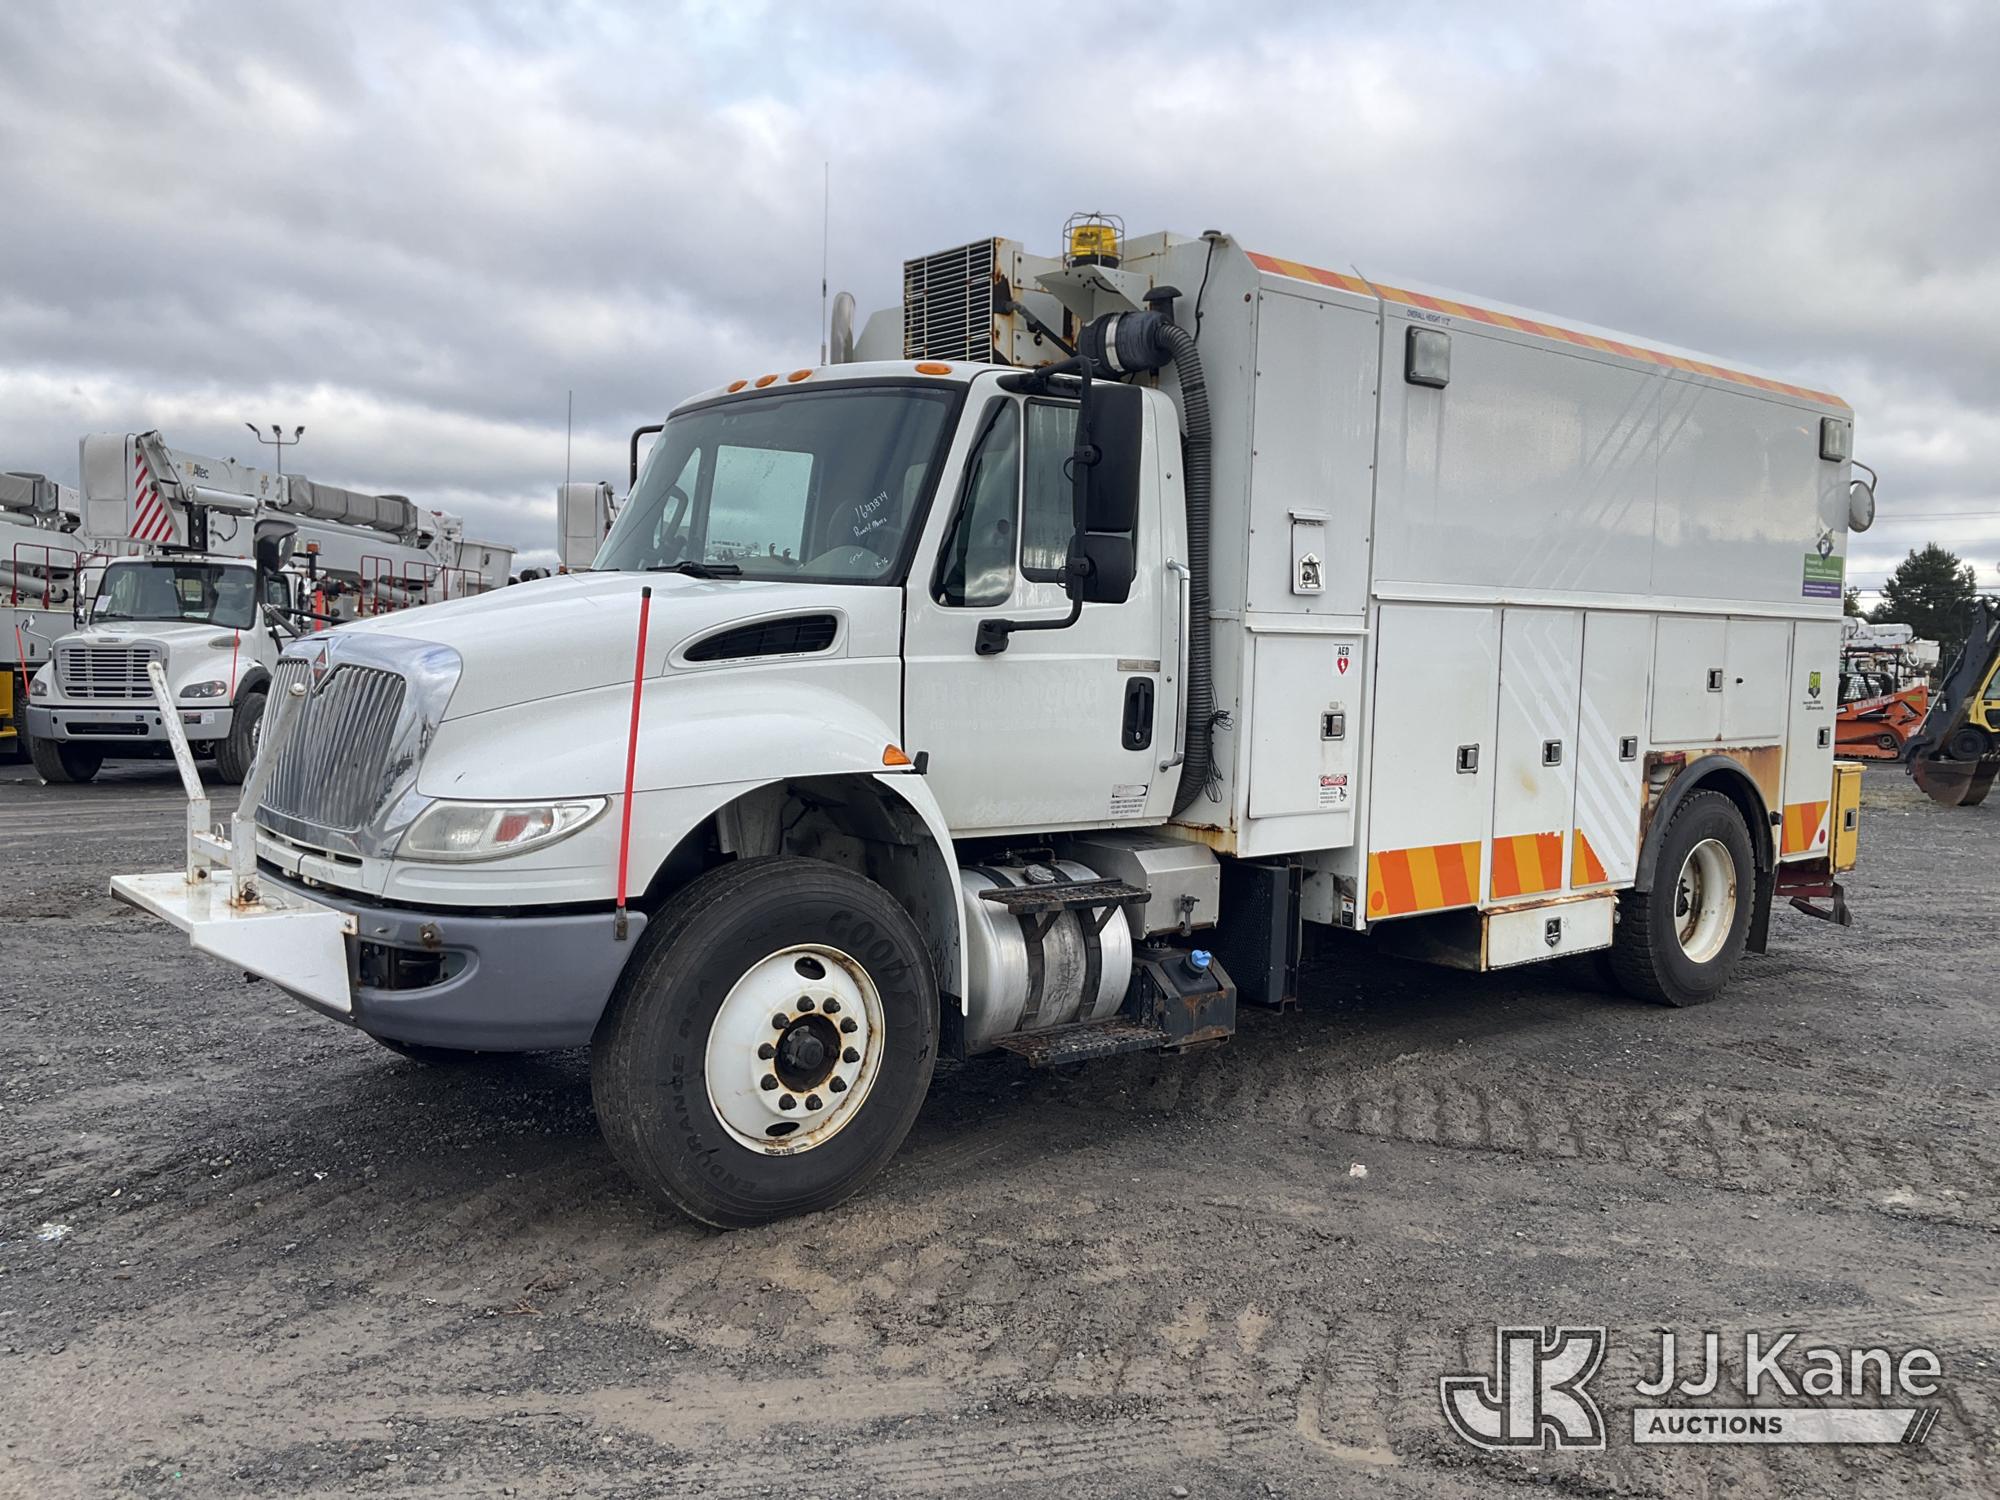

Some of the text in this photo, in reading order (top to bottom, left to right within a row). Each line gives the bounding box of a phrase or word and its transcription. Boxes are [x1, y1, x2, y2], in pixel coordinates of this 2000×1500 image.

[193, 464, 208, 478] Altec
[855, 491, 888, 523] 1643874
[1337, 646, 1350, 656] AED
[1809, 671, 1821, 689] 811
[1853, 697, 1896, 711] MANITOU
[672, 1053, 757, 1194] ENDURANCE
